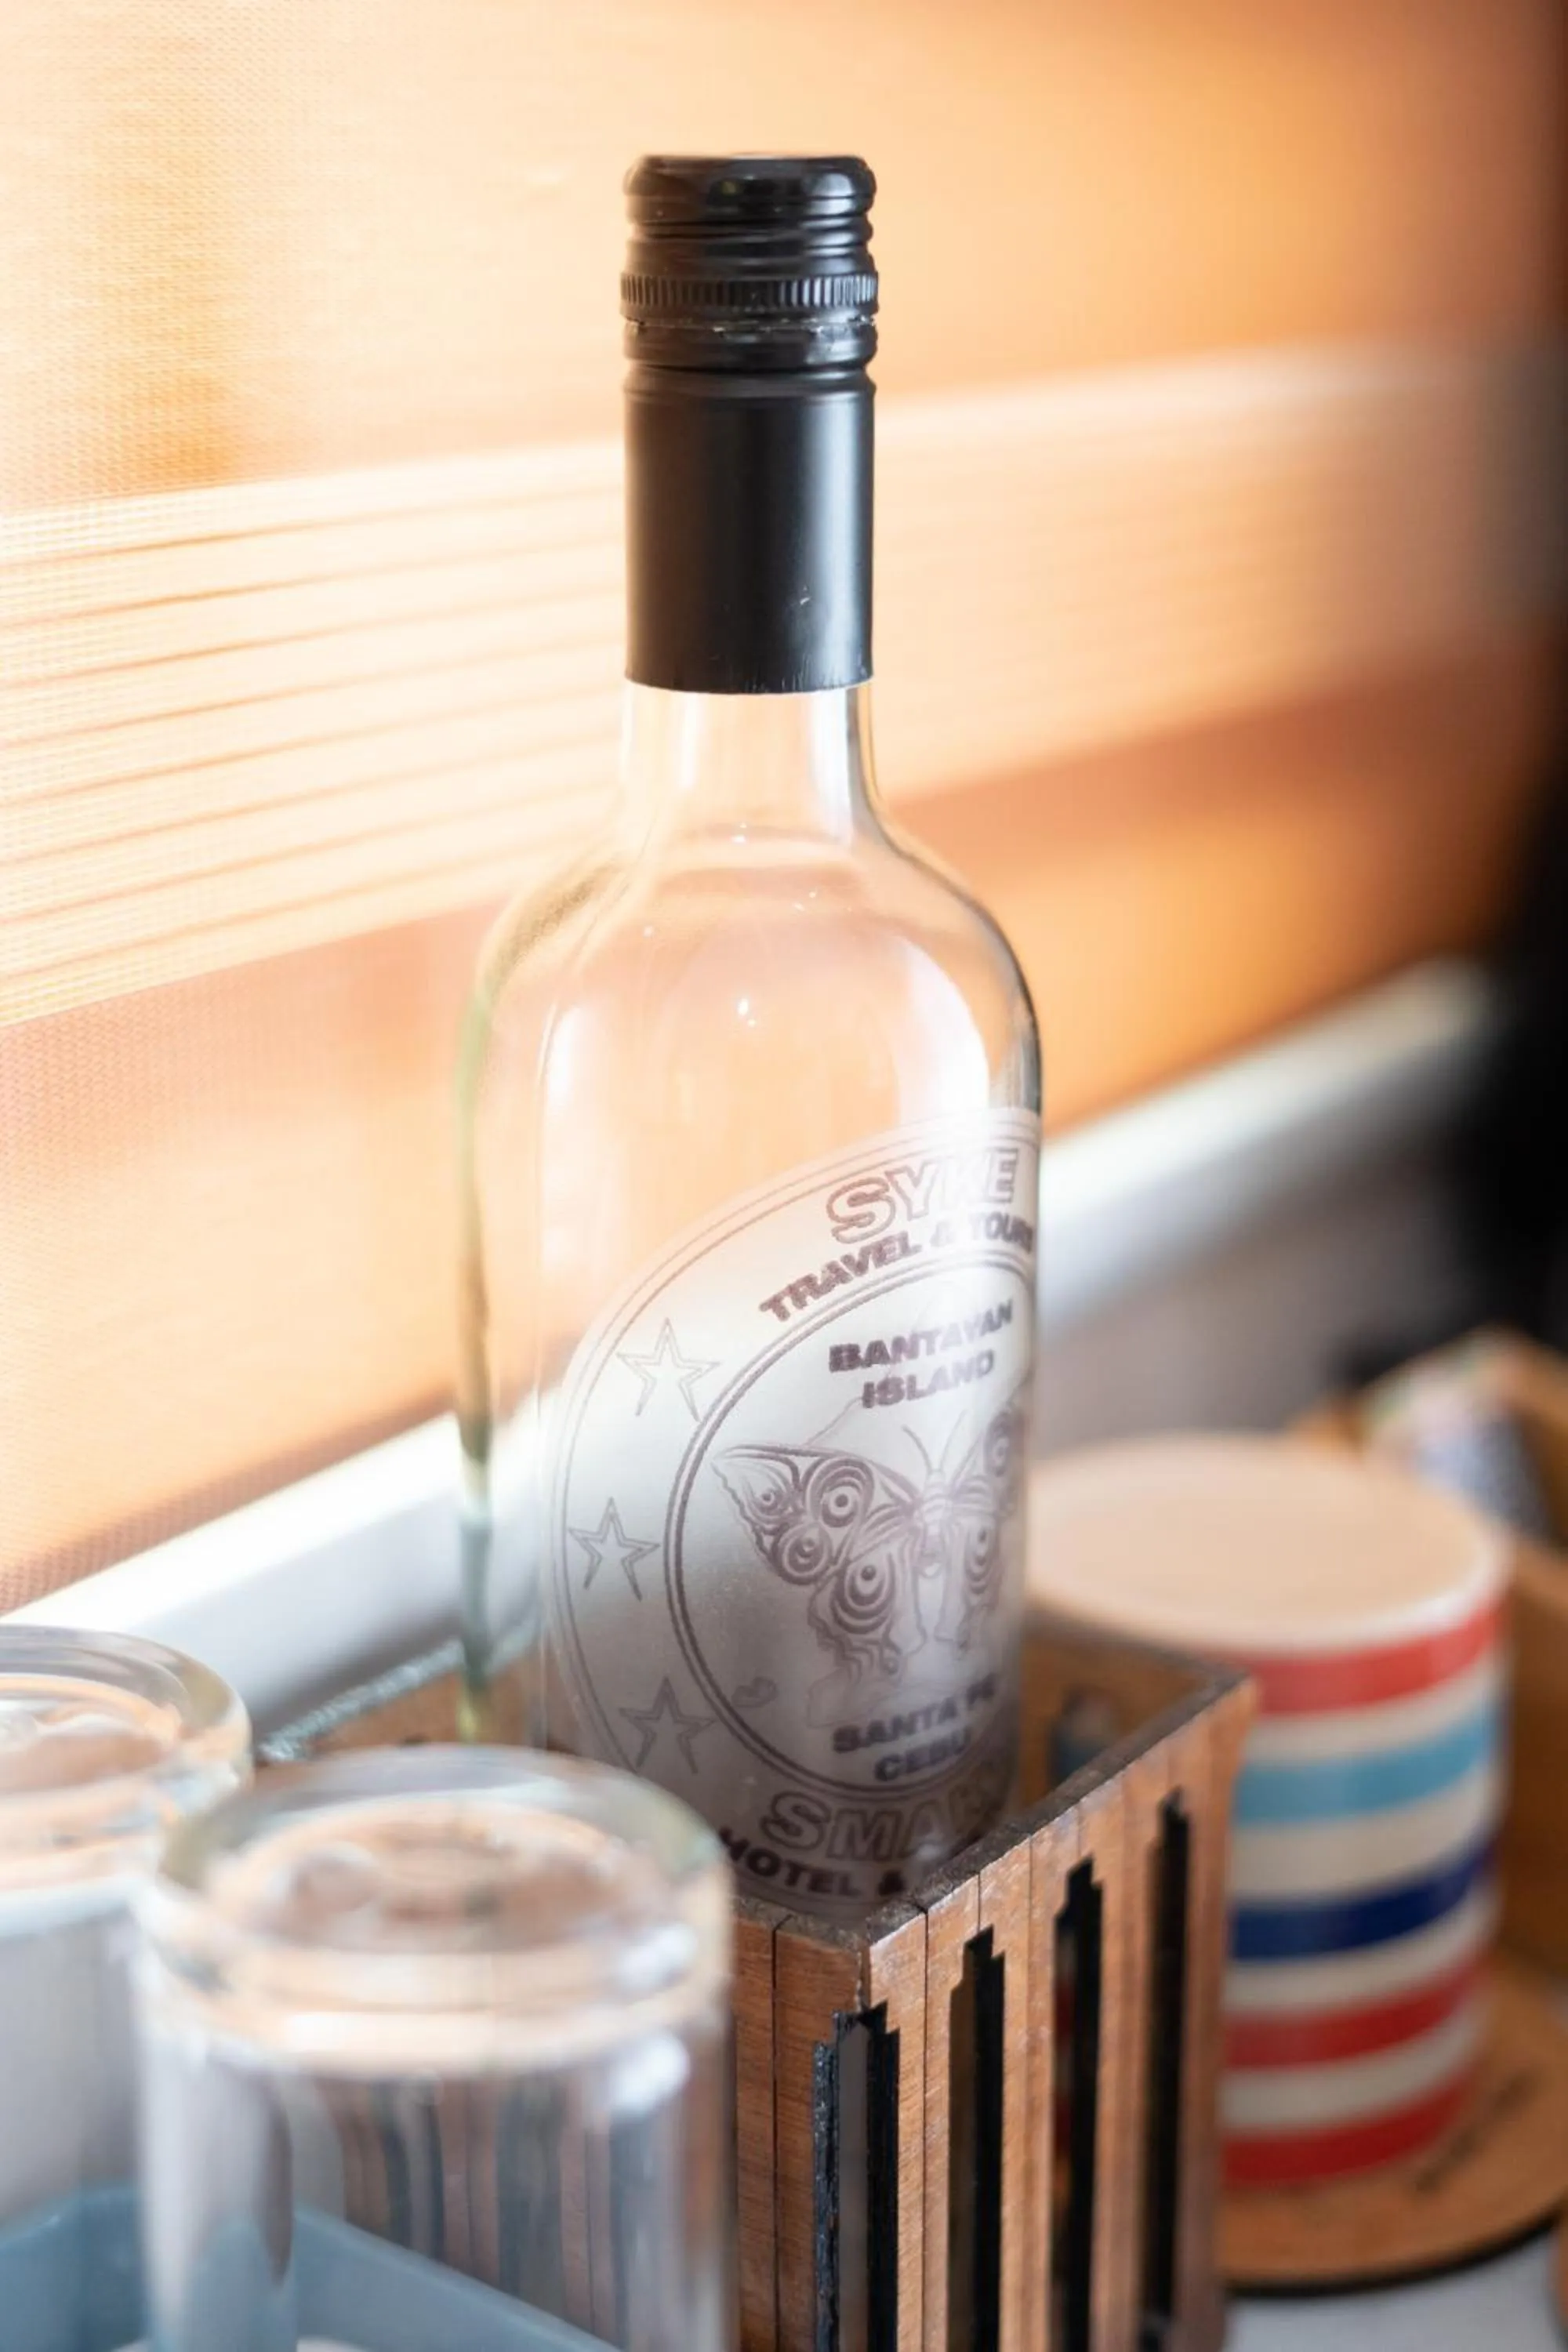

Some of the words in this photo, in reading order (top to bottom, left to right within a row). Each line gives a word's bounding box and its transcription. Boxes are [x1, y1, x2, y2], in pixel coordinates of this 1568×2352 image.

[759, 1231, 924, 1321] TRAVEL
[829, 1298, 1013, 1373] BANTAYAN
[862, 1348, 996, 1409] ISLAND
[833, 1697, 958, 1753] SANTA
[718, 1826, 859, 1895] HOTEL
